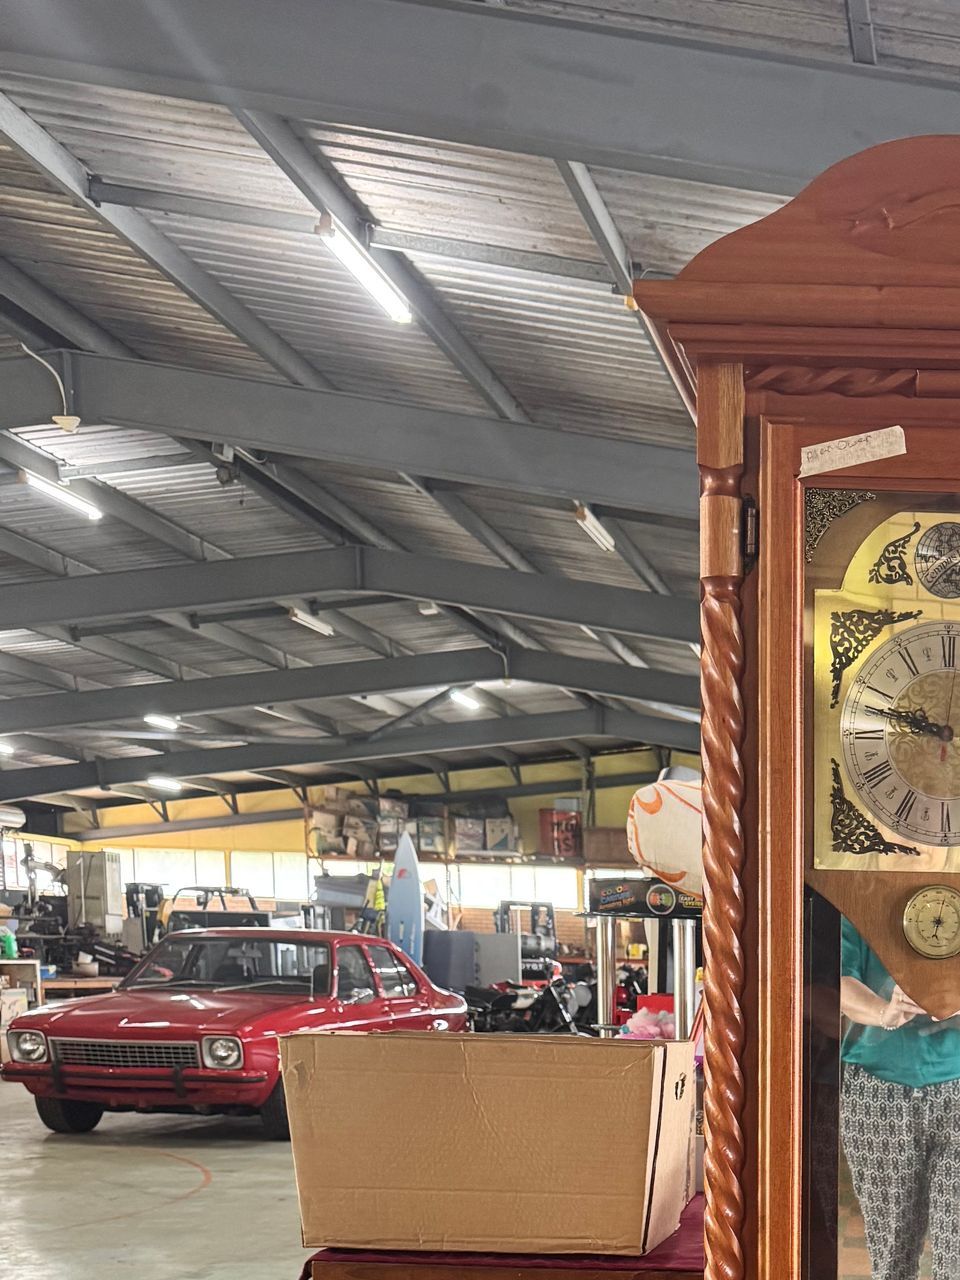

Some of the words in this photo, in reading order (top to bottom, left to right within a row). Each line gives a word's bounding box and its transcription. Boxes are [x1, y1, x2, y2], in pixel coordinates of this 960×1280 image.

[898, 646, 920, 678] XI
[941, 635, 956, 668] XII
[894, 789, 918, 822] VII
[941, 801, 952, 832] VI
